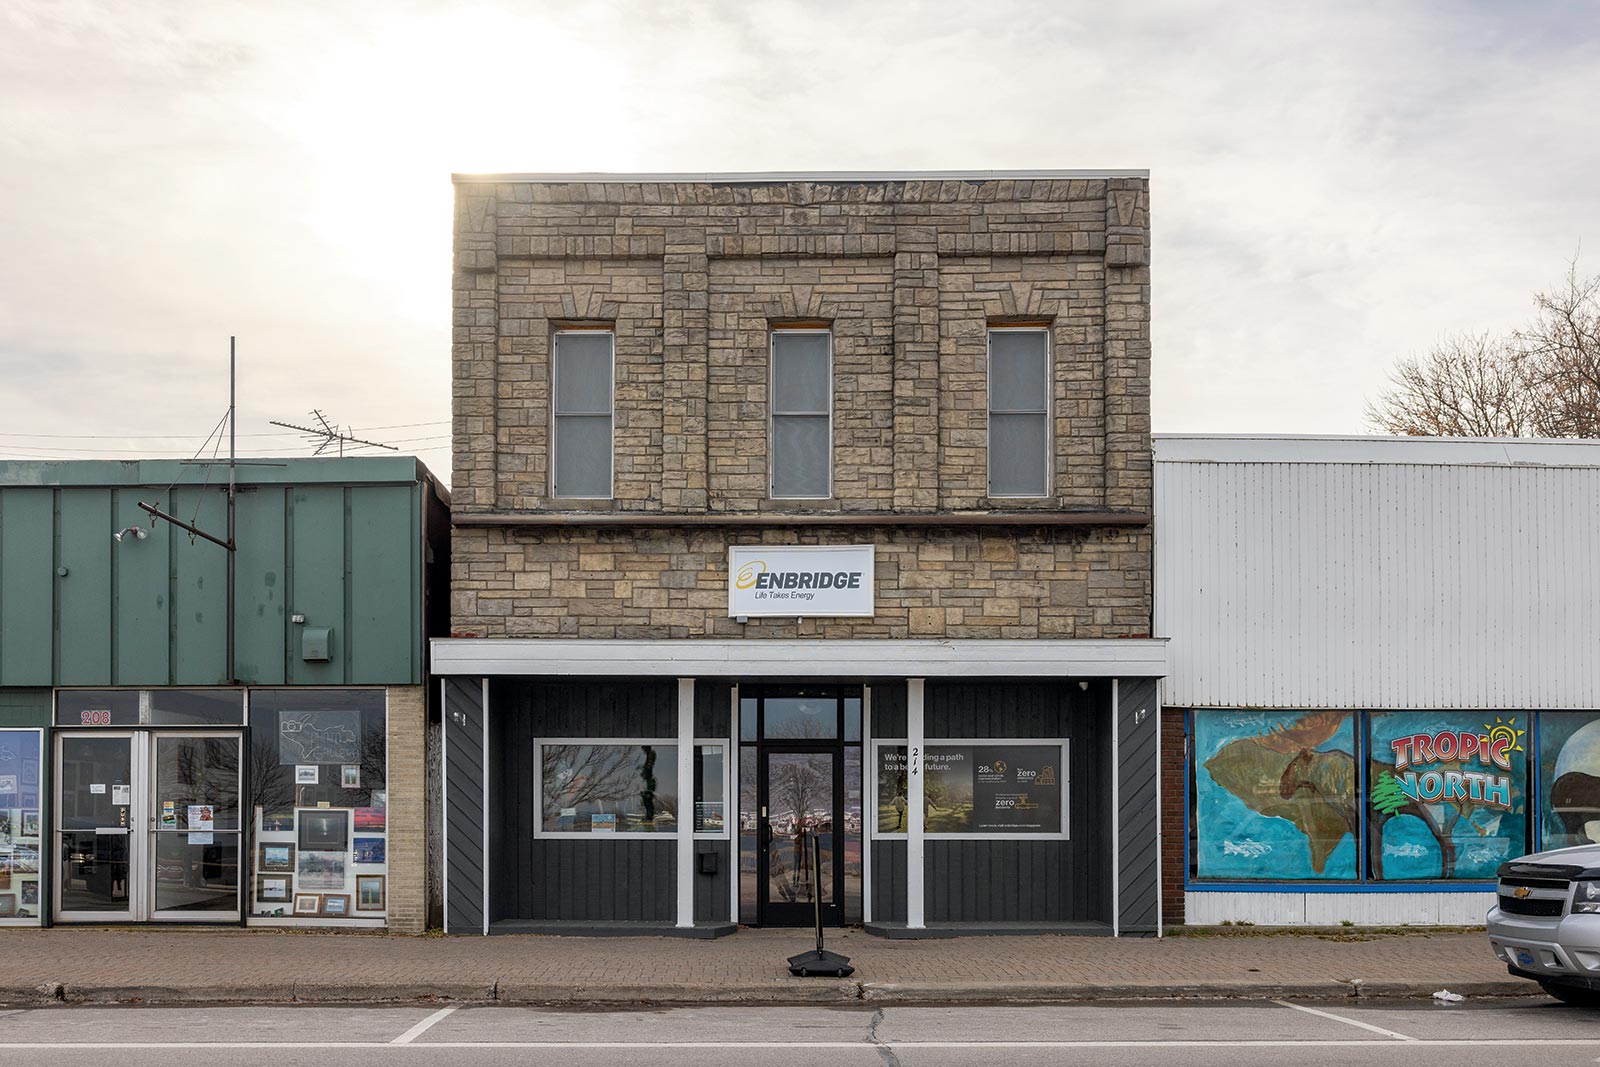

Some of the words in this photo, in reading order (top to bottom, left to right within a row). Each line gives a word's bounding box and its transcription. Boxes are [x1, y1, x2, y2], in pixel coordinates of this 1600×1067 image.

[755, 572, 861, 590] ENBRIDGE
[755, 591, 768, 599] Life
[769, 591, 789, 599] Takes
[790, 591, 815, 600] Energy
[81, 710, 111, 725] 208
[884, 753, 907, 761] We're
[945, 753, 964, 763] path
[884, 763, 893, 771] to
[924, 763, 951, 771] future.
[1395, 771, 1512, 808] NORTH
